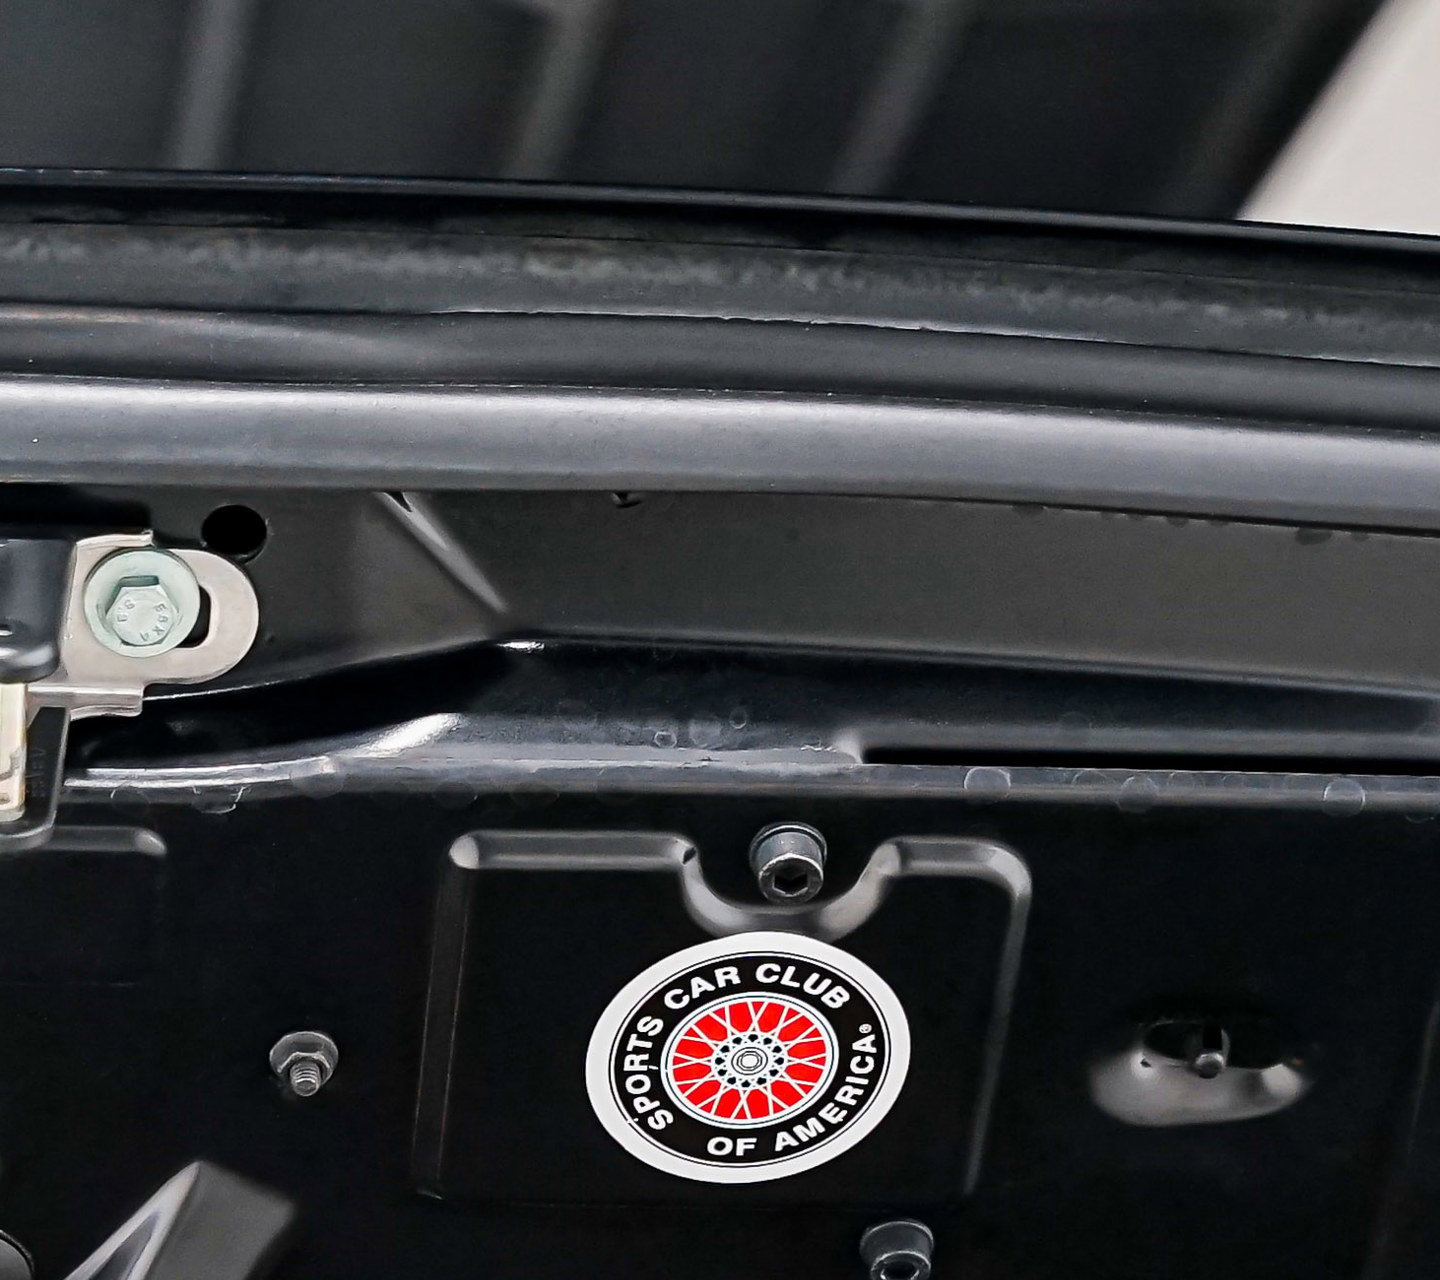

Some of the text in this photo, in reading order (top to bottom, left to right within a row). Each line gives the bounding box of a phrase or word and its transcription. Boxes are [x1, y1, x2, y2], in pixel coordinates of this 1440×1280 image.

[623, 963, 878, 1156] SPORTS CAR CLUB OF AMERICA
